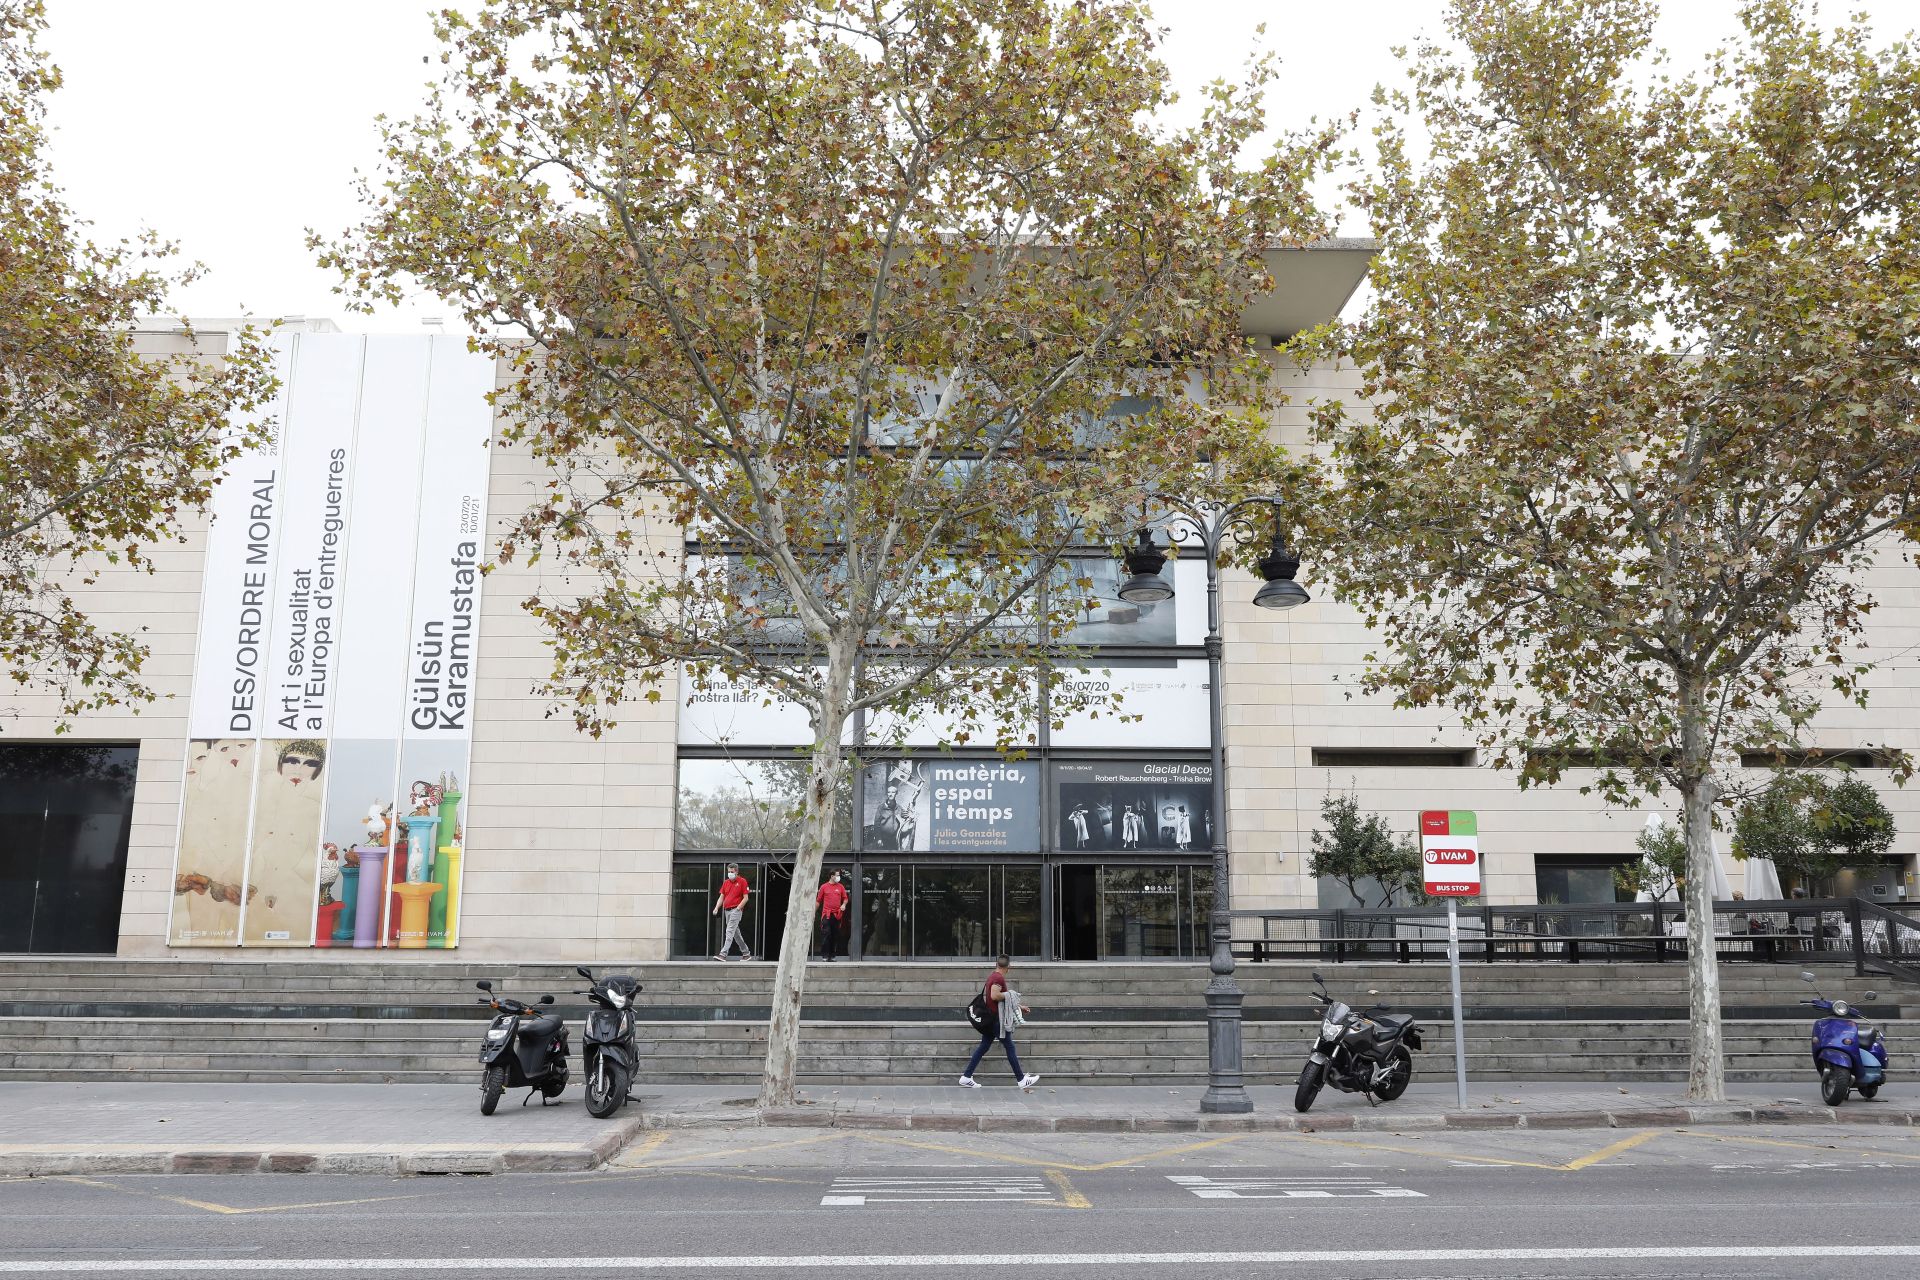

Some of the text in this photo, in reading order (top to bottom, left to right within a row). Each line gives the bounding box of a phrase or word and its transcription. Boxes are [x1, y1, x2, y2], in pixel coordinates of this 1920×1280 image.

[460, 495, 470, 534] 23/07/20
[470, 499, 480, 533] 10/01/21
[230, 470, 275, 732] DES/ORDRE MORAL
[287, 568, 311, 676] sexualitat
[439, 541, 477, 730] Karamustafa
[411, 621, 444, 730] Gülsün
[1062, 681, 1109, 691] 16/07/20
[692, 692, 759, 702] nostra llar?
[278, 695, 300, 731] Art
[306, 717, 322, 731] a
[935, 763, 1026, 784] matèria,
[1095, 774, 1118, 782] Robert
[1119, 774, 1168, 783] Rauschenberg
[1173, 774, 1194, 782] Trisha
[1143, 764, 1181, 774] Glacial
[935, 783, 992, 805] espai
[935, 802, 1013, 825] i temps
[934, 828, 1007, 838] Julio González
[952, 838, 1007, 847] avantguardes
[1427, 851, 1467, 861] 17 IVAM
[820, 1176, 1055, 1206] TAXI
